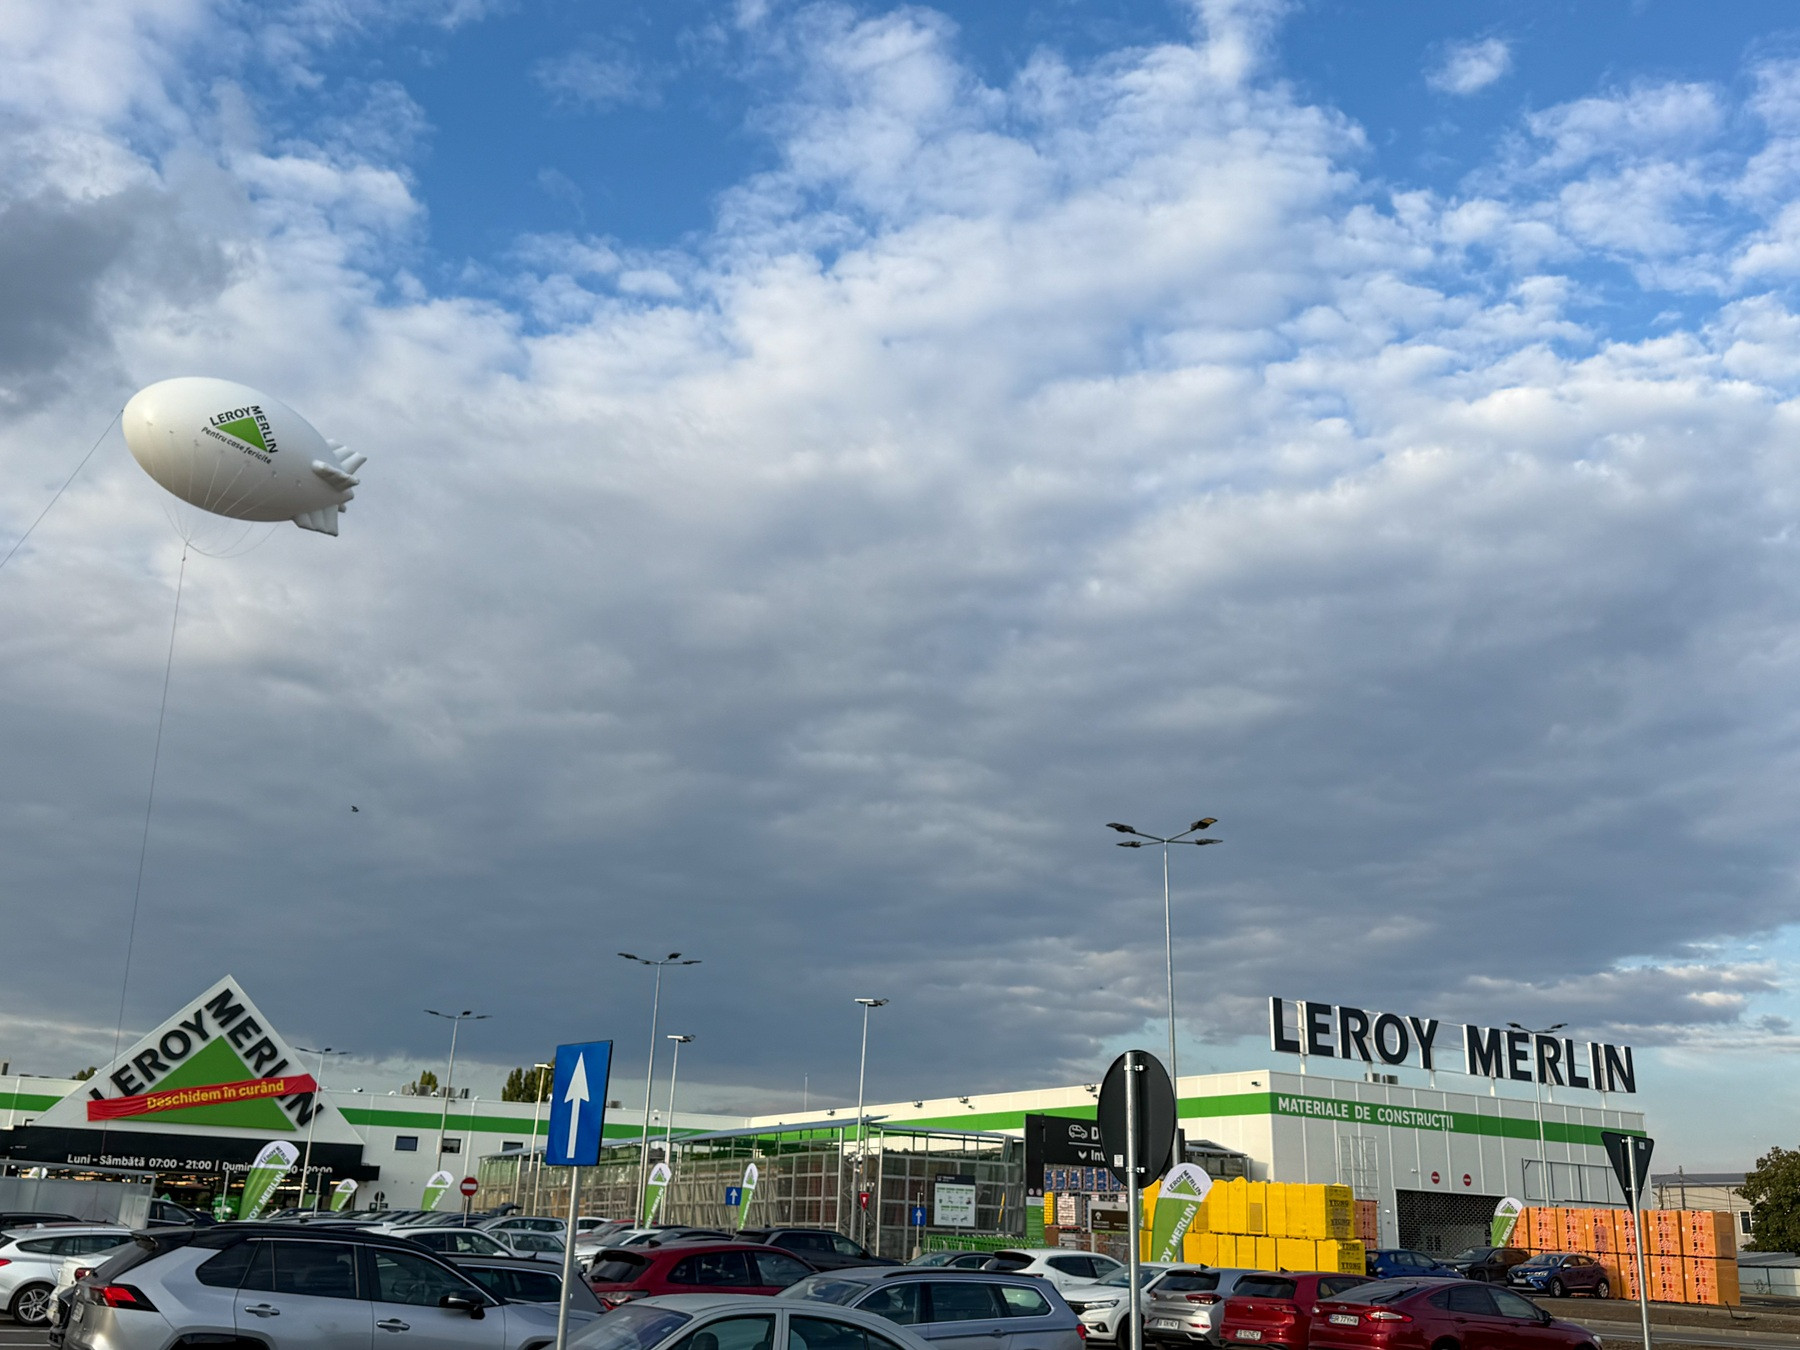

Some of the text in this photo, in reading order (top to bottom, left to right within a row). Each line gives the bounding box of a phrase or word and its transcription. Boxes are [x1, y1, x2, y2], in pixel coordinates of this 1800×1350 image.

[201, 426, 272, 465] Pentru case fericite
[209, 405, 278, 453] LEROY MERLIN
[204, 988, 324, 1127] MERN
[1269, 996, 1636, 1093] LEROY MERLIN
[147, 1080, 284, 1109] Deschidem în curând
[1278, 1096, 1349, 1119] MATERIALE
[1355, 1105, 1371, 1121] DE
[67, 1154, 91, 1164] Luni
[100, 1154, 145, 1167] Sâmbătă
[149, 1158, 177, 1169] 07:00
[185, 1159, 212, 1170] 21:00
[222, 1161, 254, 1173] Dumin
[259, 1171, 285, 1205] MERLIN
[1166, 1169, 1203, 1196] LEROY MERLIN
[1169, 1203, 1197, 1247] MERLIN
